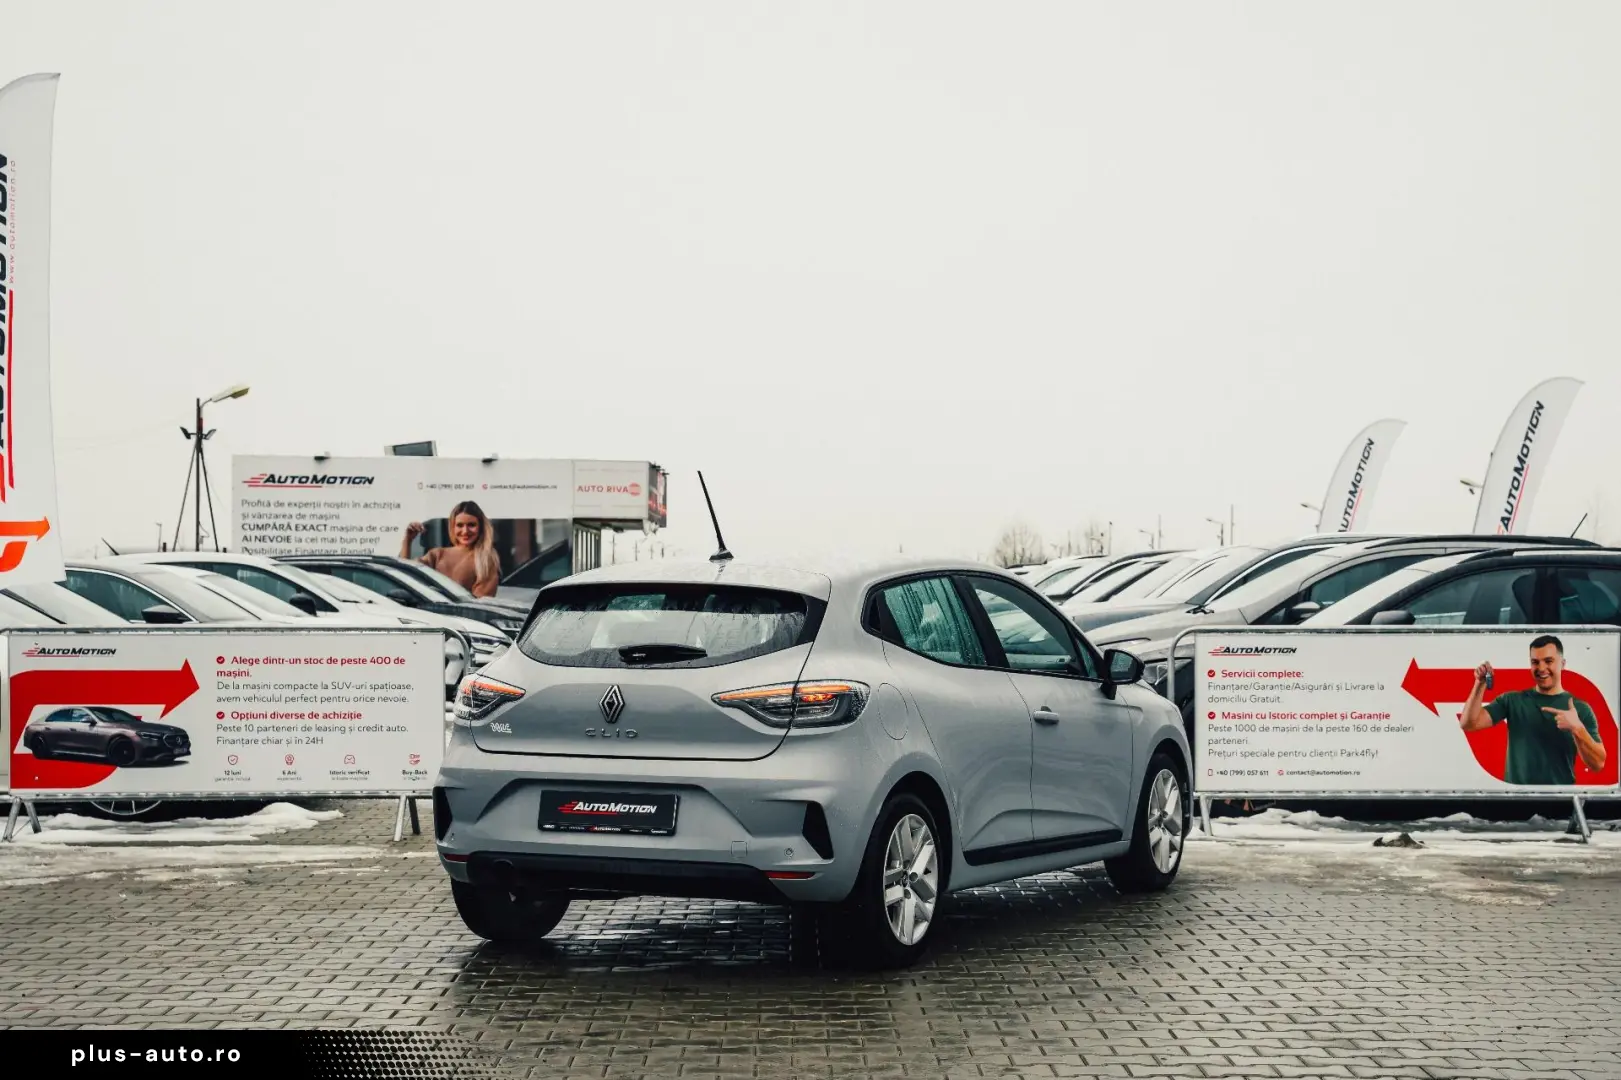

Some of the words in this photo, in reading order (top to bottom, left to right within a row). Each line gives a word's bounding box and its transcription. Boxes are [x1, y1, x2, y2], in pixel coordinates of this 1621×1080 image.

[241, 499, 271, 508] Profită
[273, 500, 285, 508] de
[287, 500, 321, 510] experții
[351, 500, 361, 509] în
[362, 500, 401, 510] achiziția
[295, 512, 307, 520] de
[241, 522, 292, 531] CUMPĂRĂ
[295, 523, 327, 531] EXACT
[330, 525, 363, 534] mașina
[365, 524, 377, 532] de
[241, 535, 252, 543] AI
[254, 535, 292, 543] NEVOIE
[320, 536, 338, 544] mai
[340, 536, 357, 544] bun
[231, 656, 260, 666] Alege
[262, 655, 301, 665] dintr-un
[303, 656, 324, 665] stoc
[326, 656, 338, 665] de
[340, 657, 367, 667] peste
[370, 656, 391, 665] 400
[393, 656, 405, 665] de
[217, 669, 252, 678] mașini.
[1221, 669, 1256, 678] Servicii
[1257, 669, 1304, 680] complete:
[217, 681, 230, 690] De
[232, 681, 240, 690] la
[273, 683, 319, 693] compacte
[321, 681, 329, 690] la
[331, 681, 367, 690] SUV-uri
[369, 682, 414, 693] spațioase,
[1335, 682, 1343, 692] și
[1345, 682, 1375, 691] Livrare
[1377, 682, 1384, 691] la
[216, 695, 241, 703] avem
[243, 694, 282, 703] vehiculul
[284, 694, 318, 705] perfect
[320, 695, 350, 705] pentru
[353, 694, 375, 703] orice
[377, 695, 409, 703] nevoie.
[1208, 694, 1247, 703] domiciliu
[231, 711, 268, 721] Opțiuni
[270, 711, 306, 720] diverse
[308, 711, 319, 720] de
[322, 711, 362, 721] achiziție
[1269, 712, 1297, 720] Istoric
[1299, 712, 1338, 721] complet
[1340, 712, 1348, 721] și
[1350, 712, 1391, 721] Garanție
[217, 724, 241, 732] Peste
[244, 724, 254, 732] 10
[257, 724, 298, 734] parteneri
[301, 724, 313, 732] de
[315, 724, 346, 735] leasing
[348, 724, 355, 735] și
[357, 723, 384, 733] credit
[386, 725, 408, 733] auto.
[585, 728, 638, 738] CLIO
[1325, 726, 1351, 734] peste
[216, 737, 259, 747] Finanțare
[261, 737, 283, 745] chiar
[286, 737, 292, 747] și
[305, 737, 324, 745] 24H
[1208, 750, 1238, 759] Prețuri
[1240, 750, 1276, 759] speciale
[1277, 750, 1307, 759] pentru
[1309, 750, 1338, 759] clienții
[1340, 749, 1378, 760] Park4fly!
[1229, 769, 1245, 777] (799)
[1286, 769, 1361, 777] contact@automotion.ro
